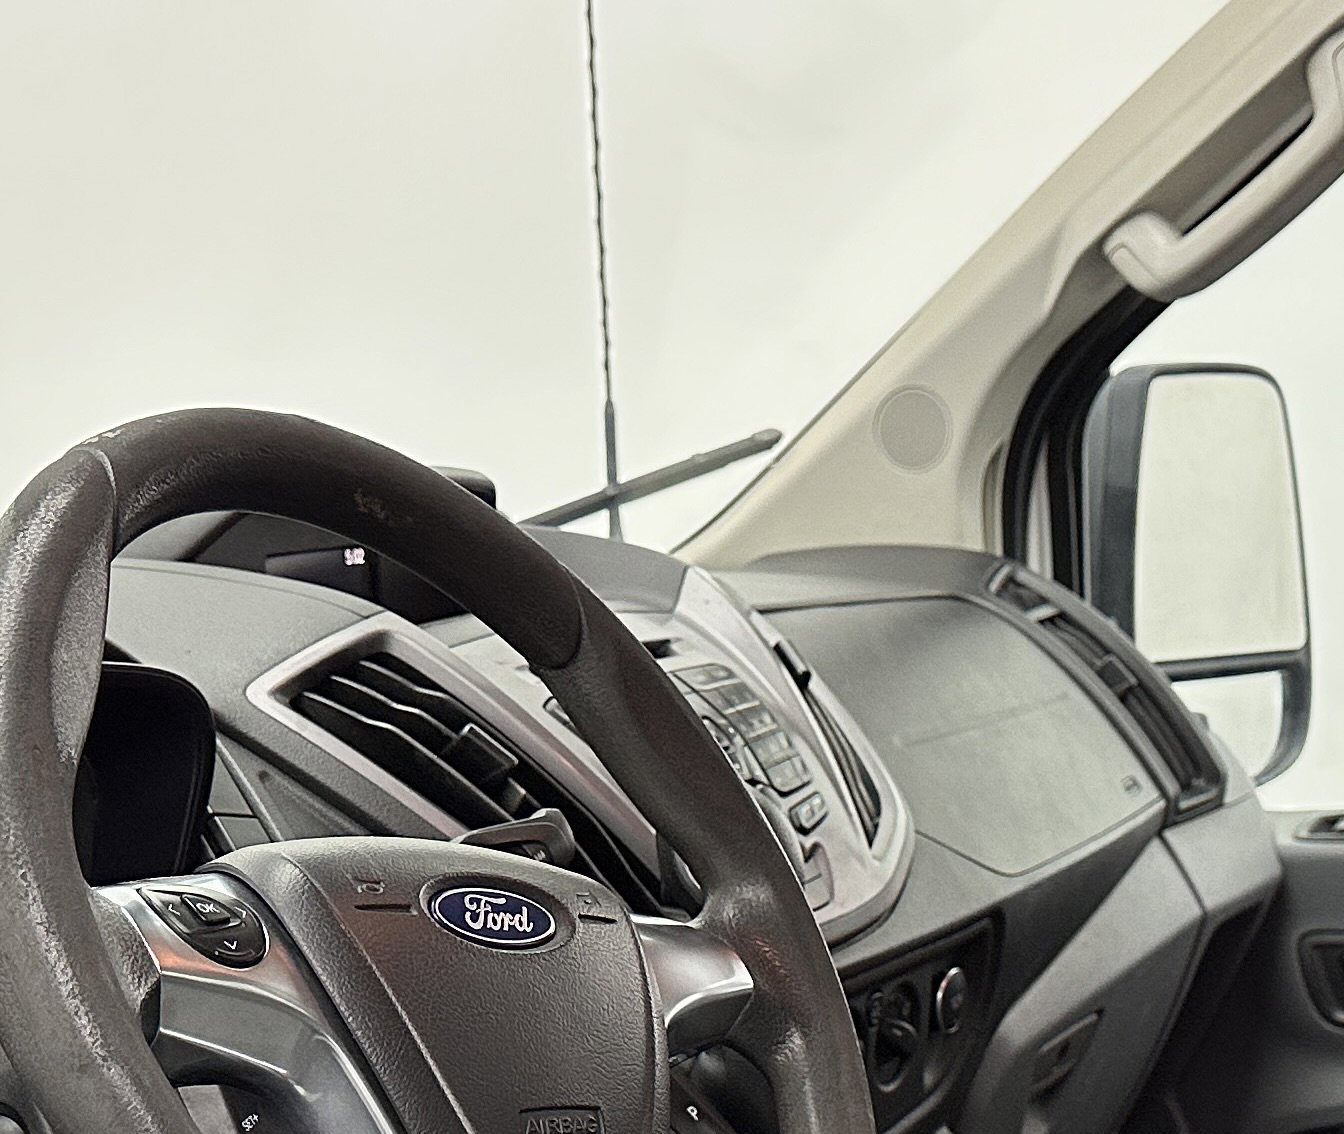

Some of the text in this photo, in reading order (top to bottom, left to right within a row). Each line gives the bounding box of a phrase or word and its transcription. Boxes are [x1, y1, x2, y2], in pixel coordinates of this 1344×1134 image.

[195, 902, 221, 914] OK
[463, 893, 534, 933] Ford
[686, 1105, 699, 1121] P
[241, 1113, 259, 1132] SET+
